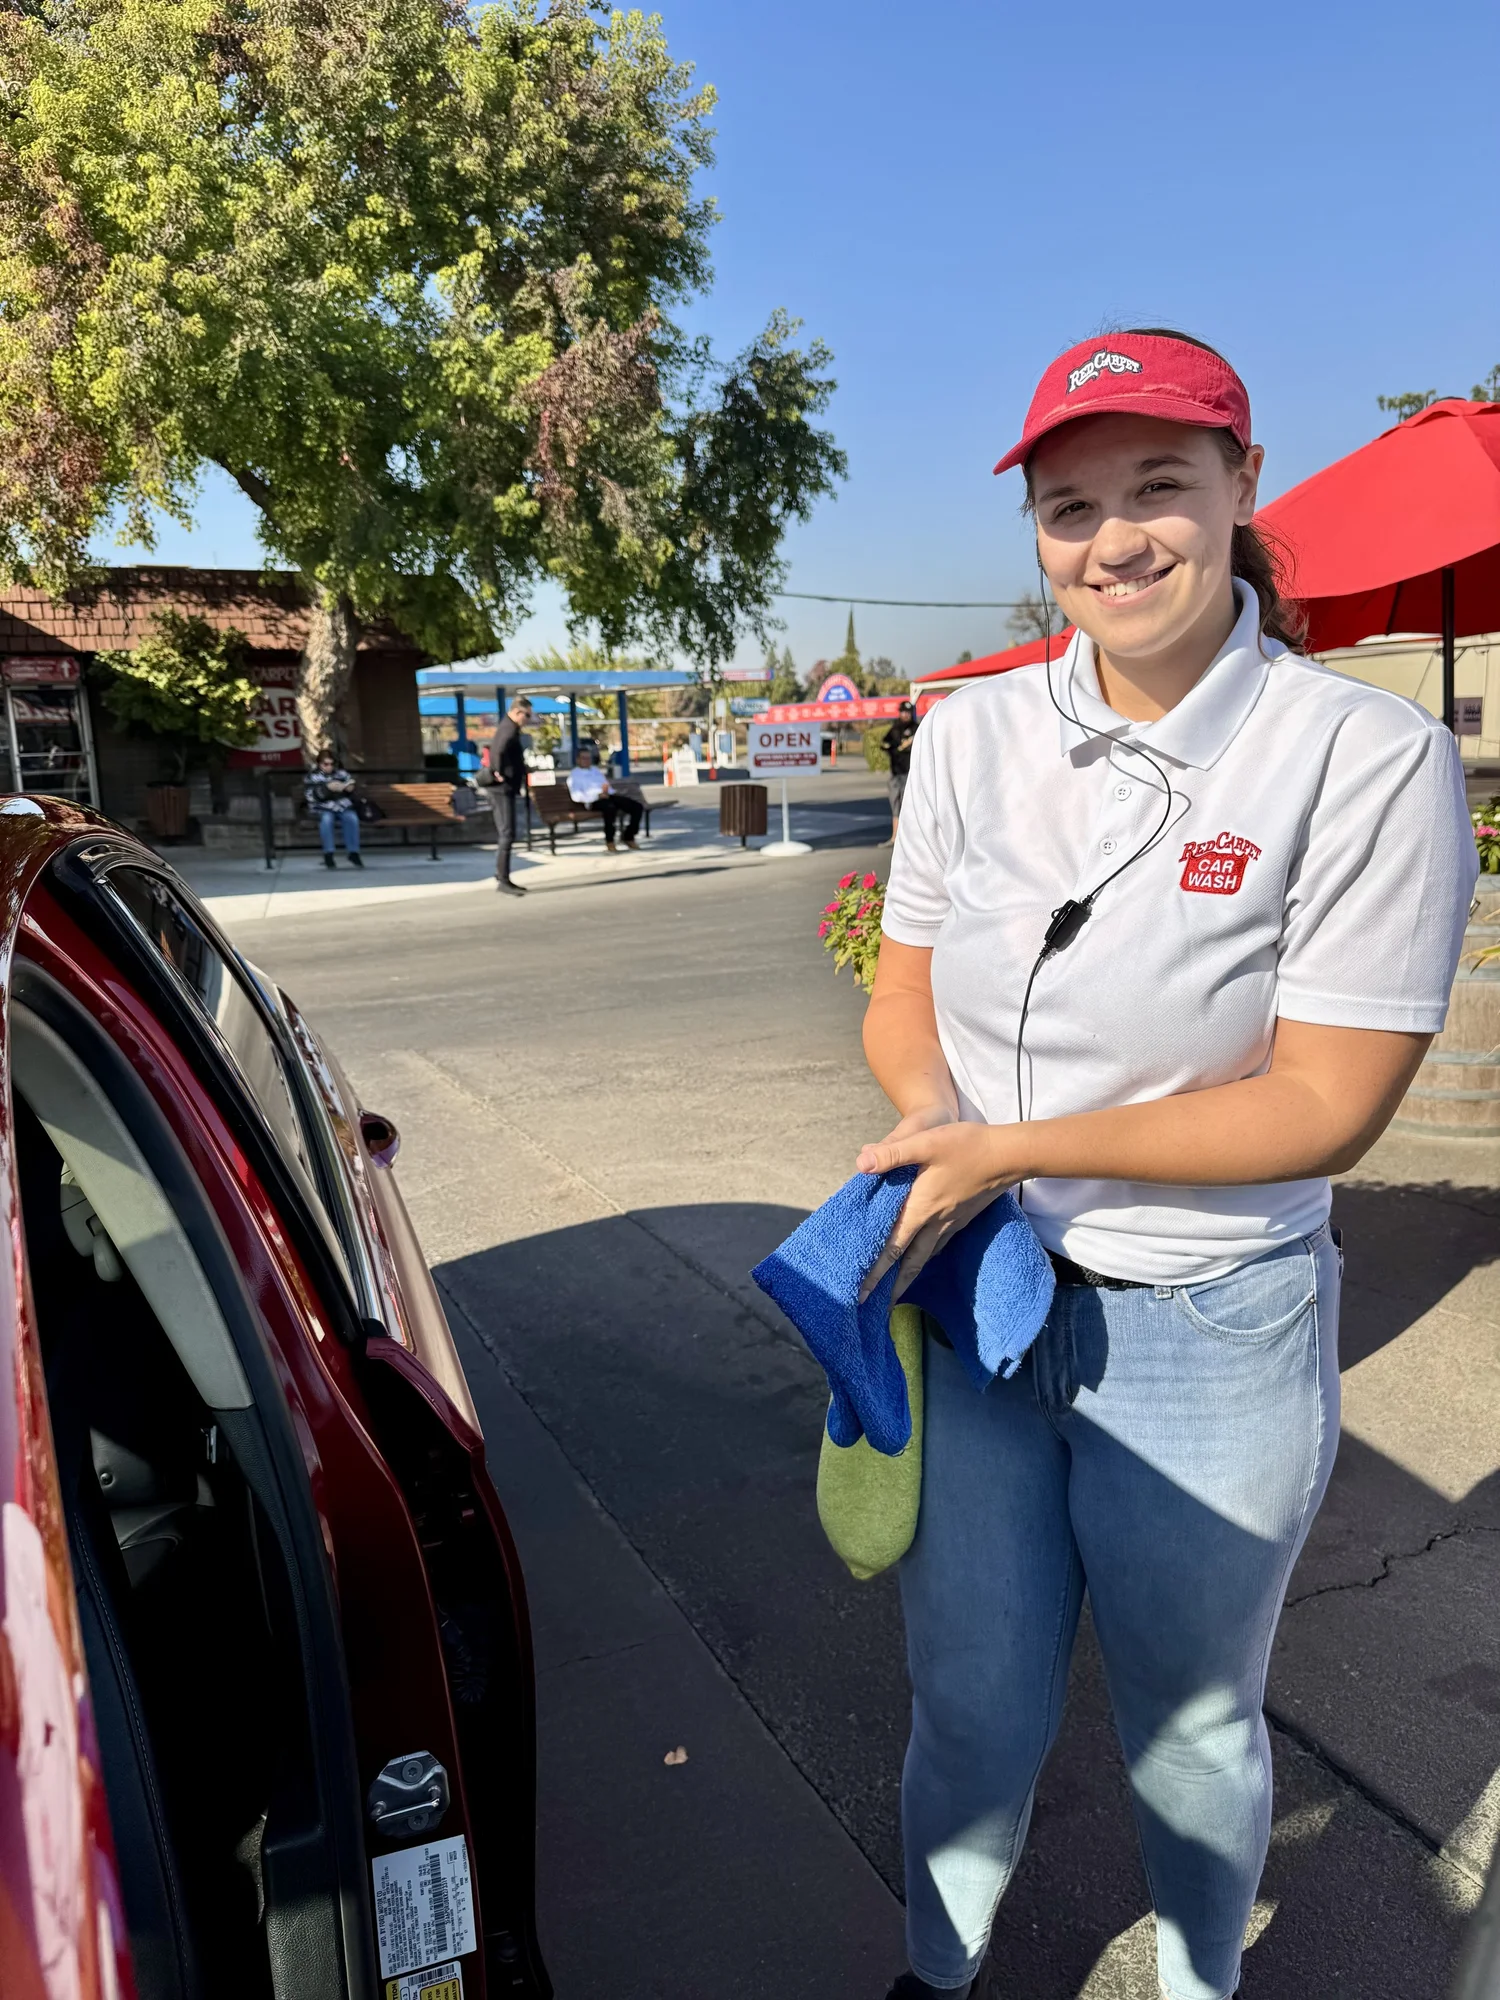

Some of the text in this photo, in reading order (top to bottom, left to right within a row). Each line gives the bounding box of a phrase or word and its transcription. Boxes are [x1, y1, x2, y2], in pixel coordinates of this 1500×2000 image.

[759, 732, 811, 748] OPEN
[1198, 859, 1234, 874] CAR
[1188, 873, 1238, 890] WASH
